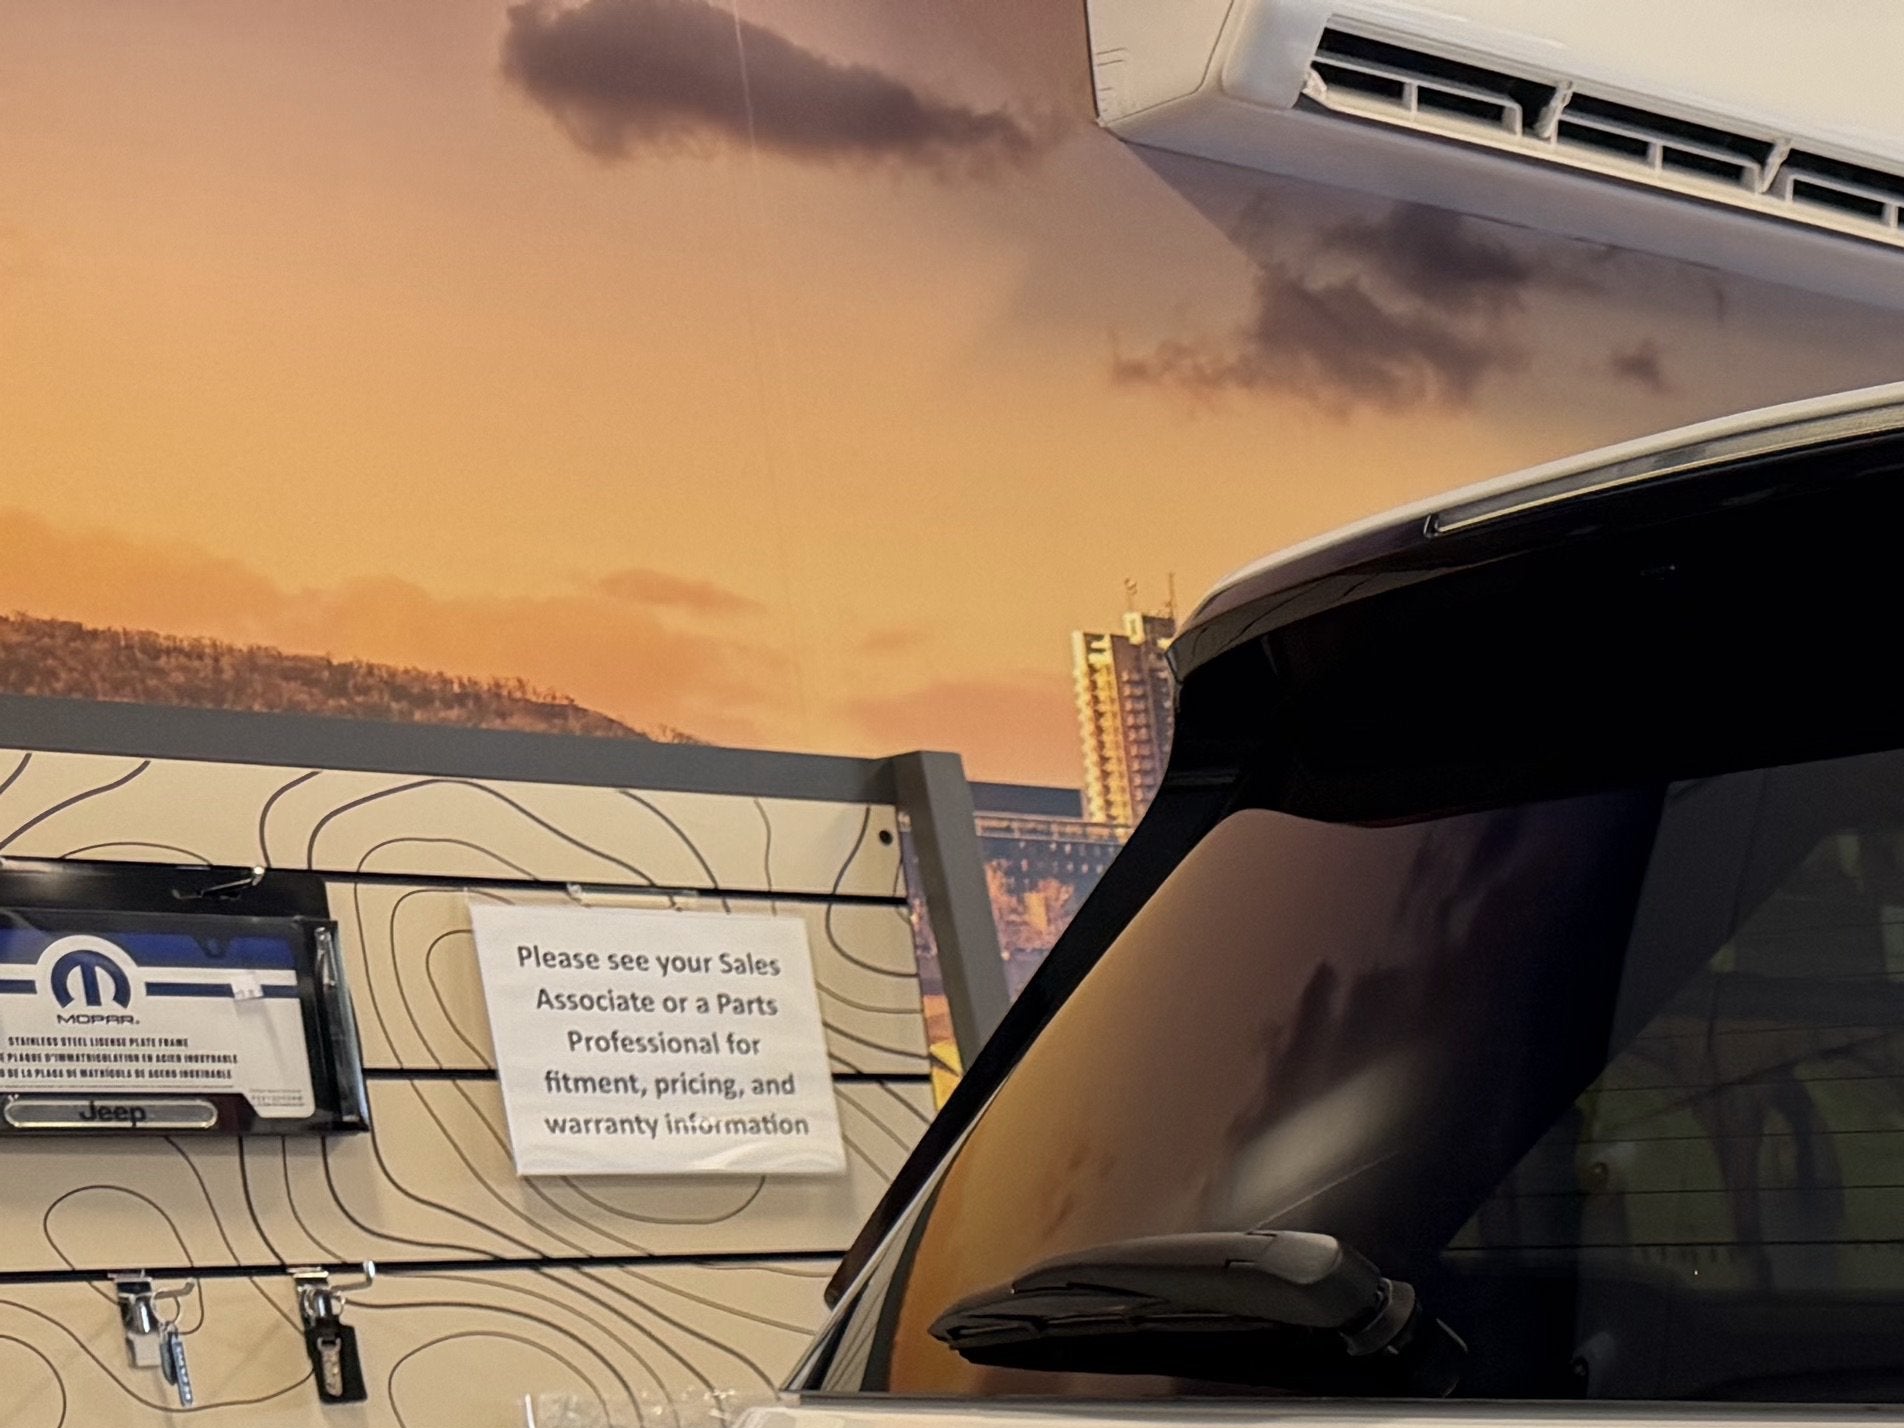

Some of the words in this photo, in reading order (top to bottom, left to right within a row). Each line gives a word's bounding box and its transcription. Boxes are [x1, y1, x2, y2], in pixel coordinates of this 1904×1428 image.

[516, 945, 600, 970] Please
[607, 952, 651, 971] see
[655, 953, 712, 977] your
[719, 952, 781, 976] Sales
[536, 988, 655, 1013] Associate
[662, 994, 688, 1014] or
[696, 996, 710, 1014] a
[717, 993, 778, 1016] Parts
[8, 1036, 58, 1047] STAINLESS
[61, 1037, 87, 1047] STEEL
[129, 1037, 156, 1047] PLATE
[567, 1030, 720, 1055] Professional
[725, 1032, 760, 1056] for
[545, 1070, 648, 1098] fitment,
[654, 1072, 745, 1100] pricing,
[751, 1072, 796, 1096] and
[79, 1101, 146, 1127] Jeep
[545, 1117, 659, 1140] warranty
[666, 1113, 809, 1136] information
